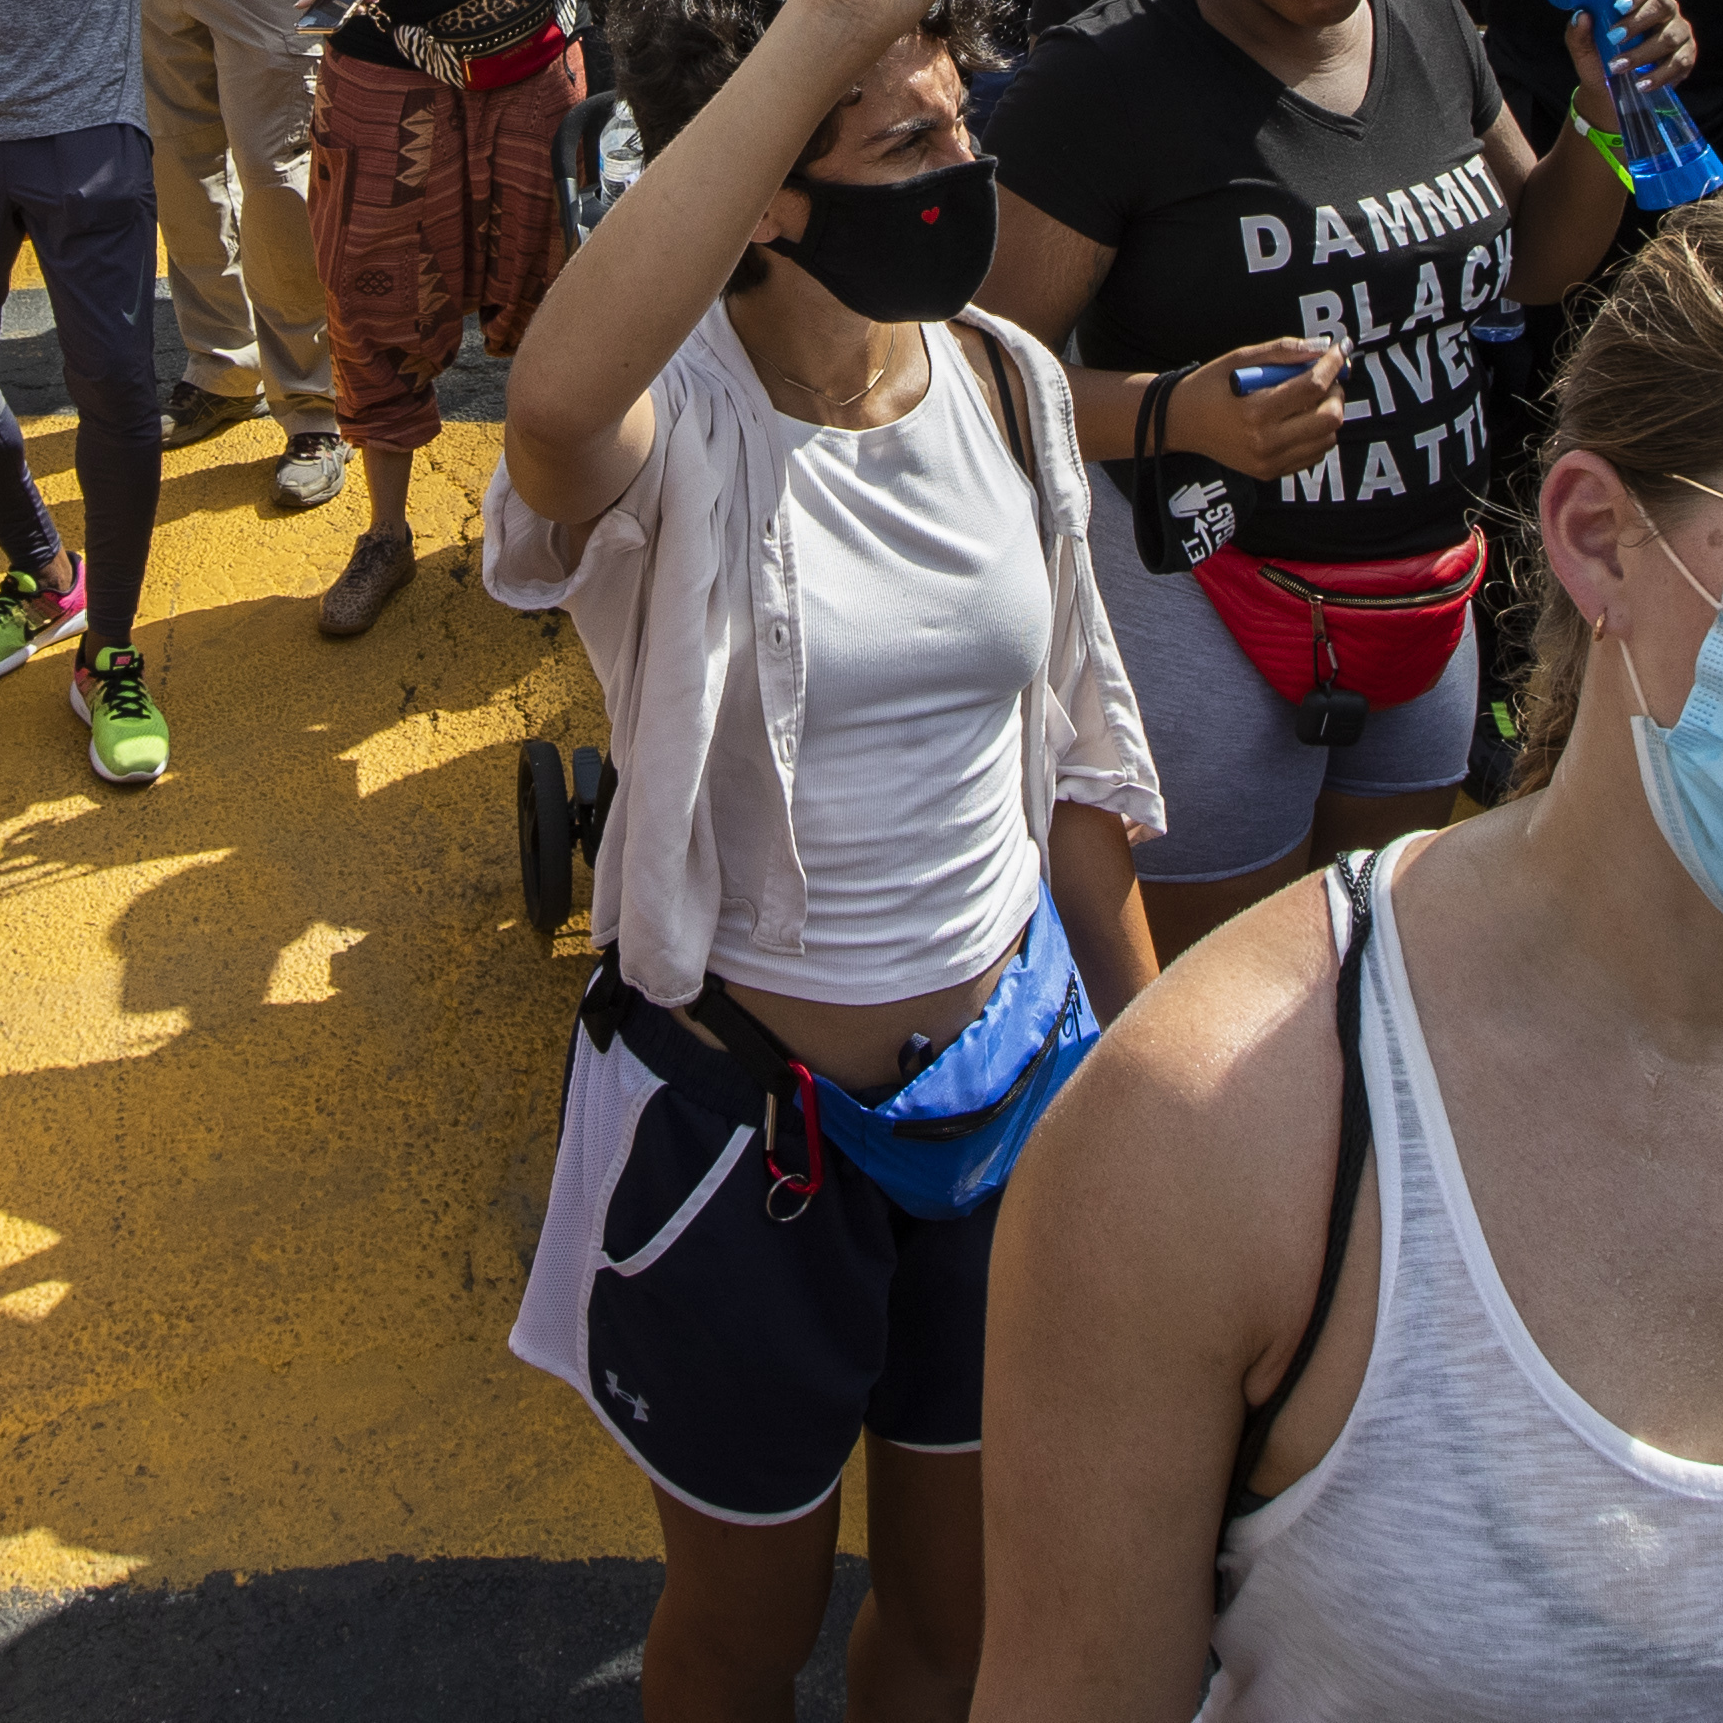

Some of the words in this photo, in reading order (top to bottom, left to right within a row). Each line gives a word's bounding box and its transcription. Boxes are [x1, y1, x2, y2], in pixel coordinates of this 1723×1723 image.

[1240, 153, 1504, 274] DAMMIT
[1298, 227, 1513, 346] BLACK
[1181, 537, 1207, 566] ET
[1204, 501, 1237, 551] GAS
